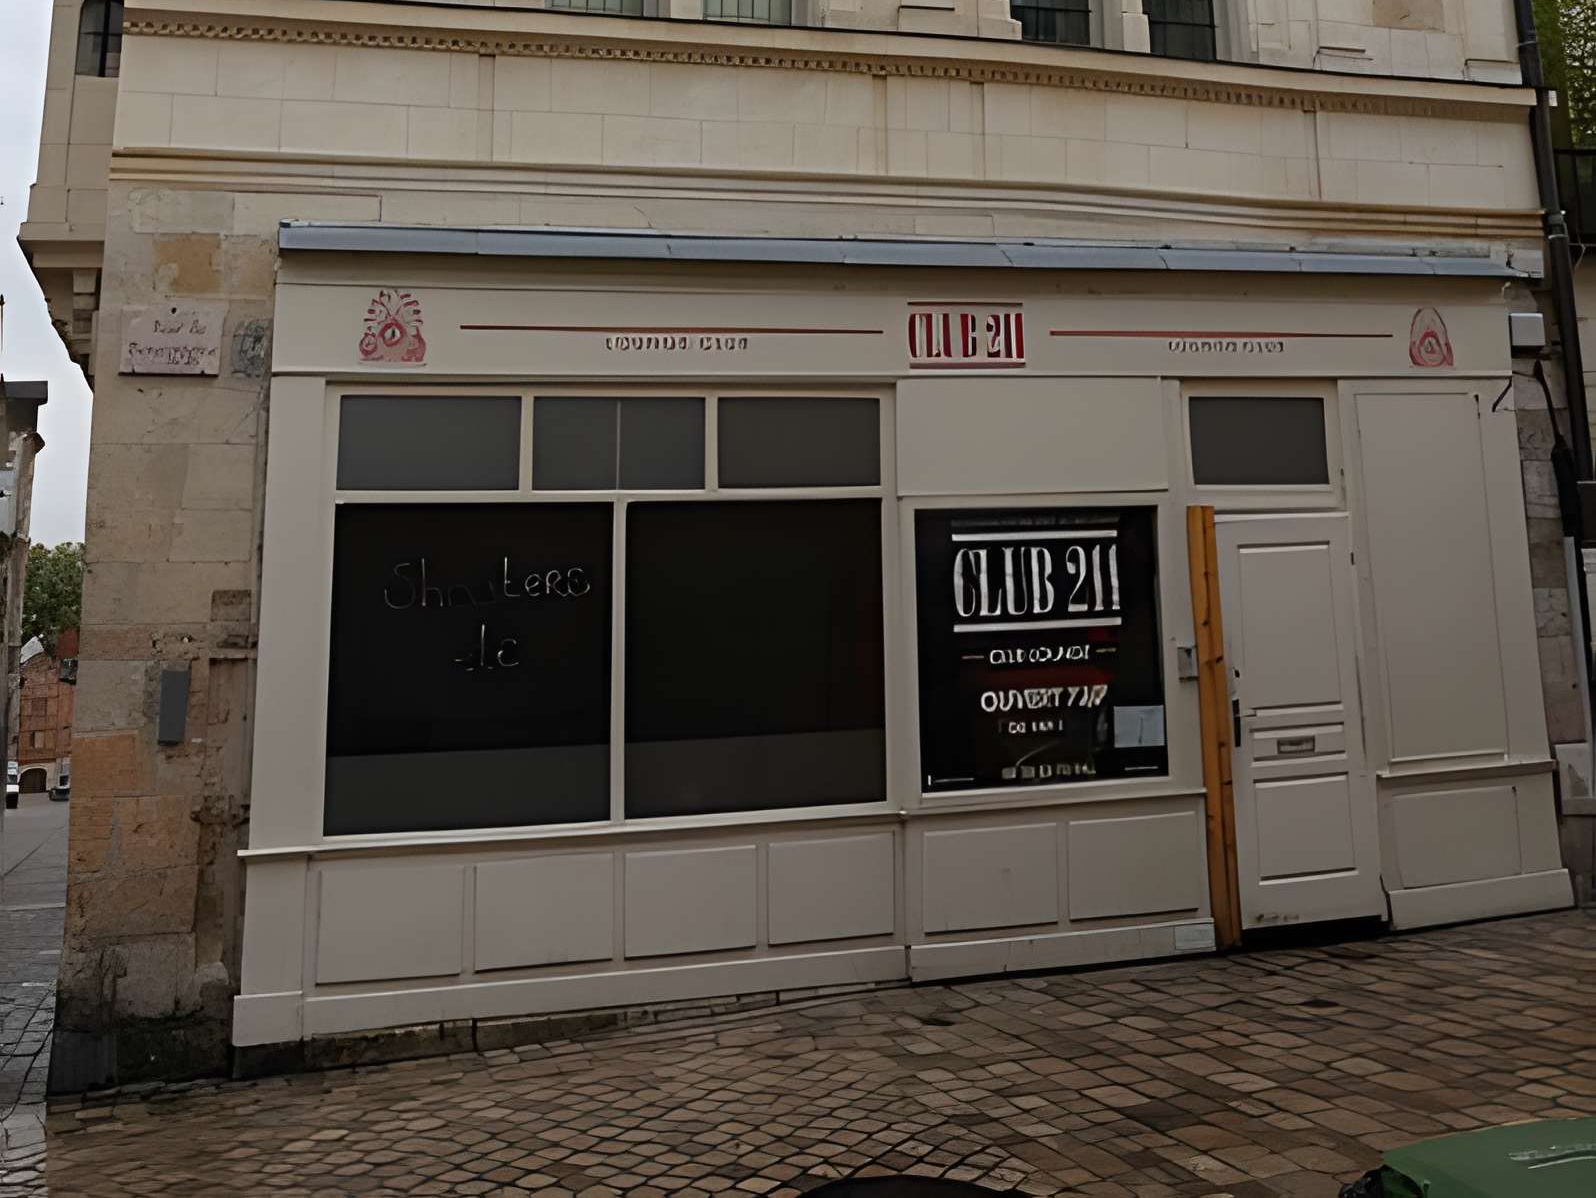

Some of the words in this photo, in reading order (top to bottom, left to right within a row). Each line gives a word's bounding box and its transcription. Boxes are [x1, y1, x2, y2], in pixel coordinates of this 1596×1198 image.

[908, 312, 978, 358] CLUB
[985, 312, 1025, 359] 211
[952, 546, 1056, 618] CLUB
[1065, 543, 1122, 613] 211
